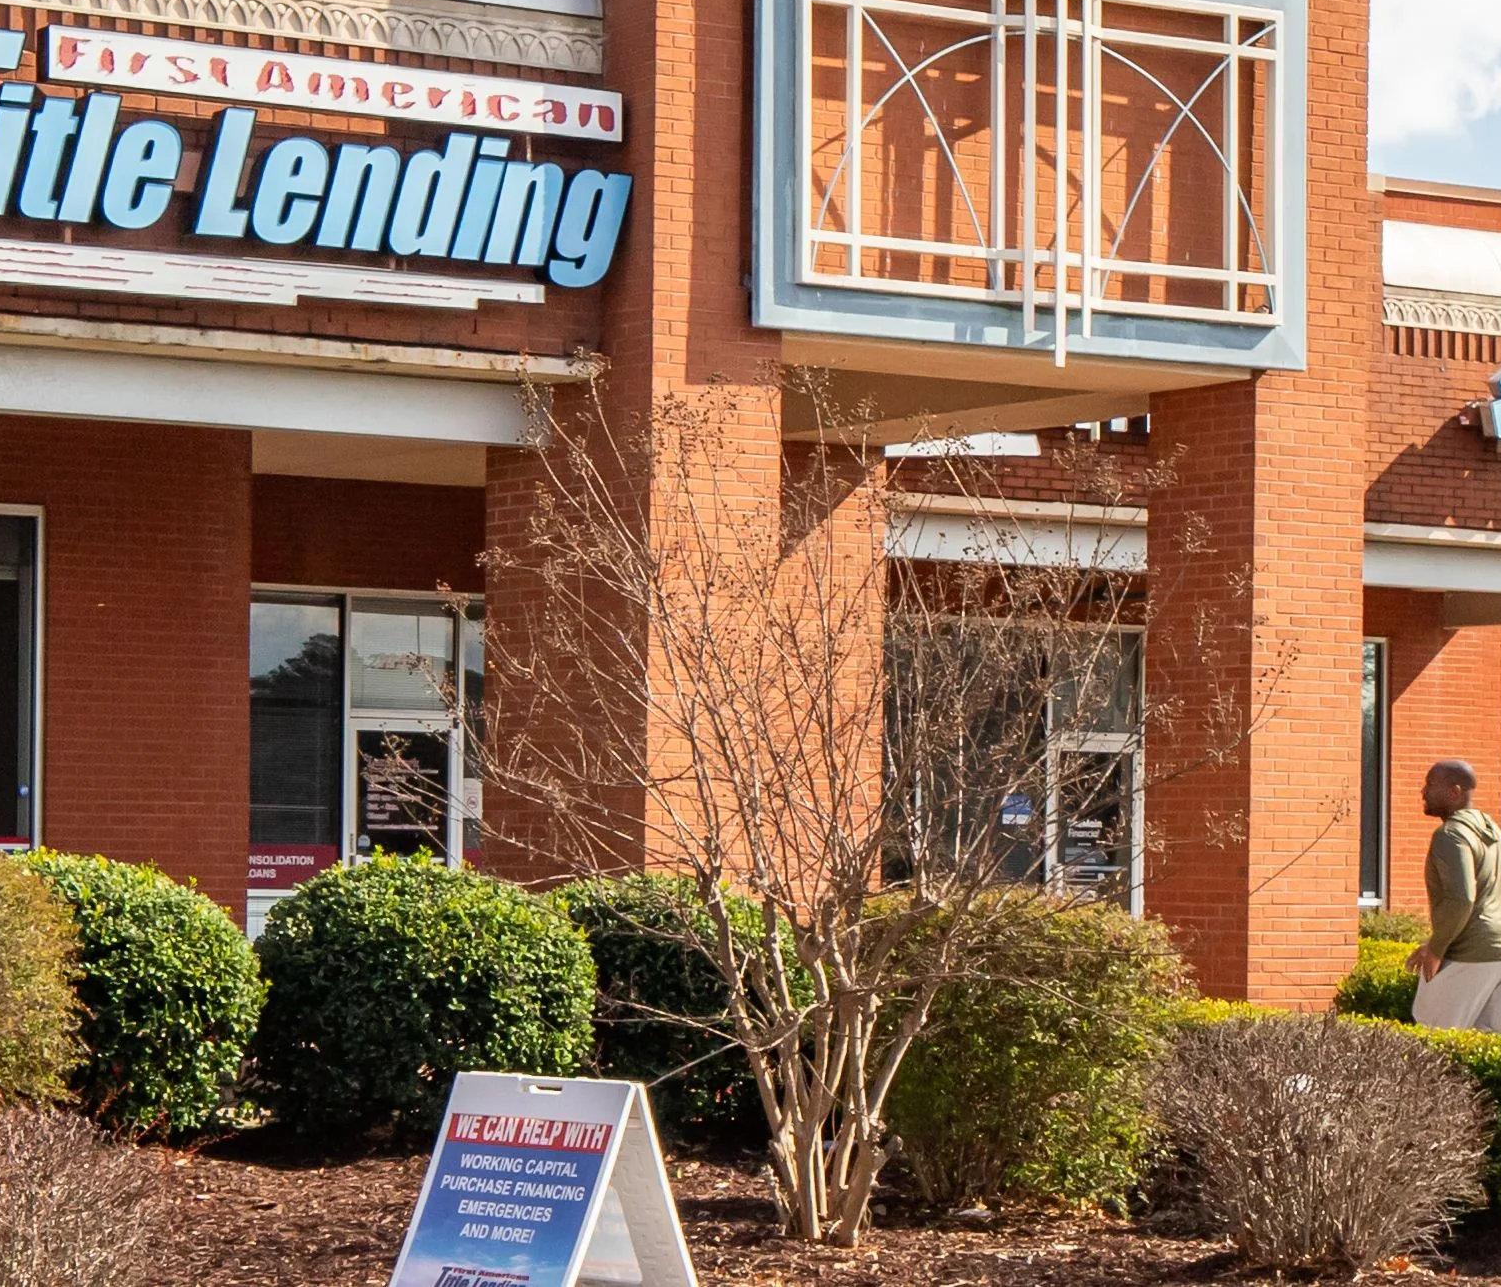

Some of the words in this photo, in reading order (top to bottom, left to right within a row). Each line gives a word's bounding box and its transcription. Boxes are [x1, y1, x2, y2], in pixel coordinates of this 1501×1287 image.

[55, 33, 235, 89] First
[253, 56, 617, 134] American
[191, 106, 635, 289] Lending
[455, 1115, 479, 1140] WE
[483, 1116, 518, 1143] CAN
[519, 1120, 563, 1147] HELP
[563, 1124, 607, 1149] WITH
[460, 1153, 523, 1173] WORKING
[525, 1160, 578, 1178] CAPITAL
[440, 1175, 512, 1195] PURCHASE
[513, 1182, 586, 1202] FINANCING
[457, 1199, 553, 1223] EMERGENCIES
[459, 1223, 488, 1239] AND
[490, 1226, 536, 1244] MORE!
